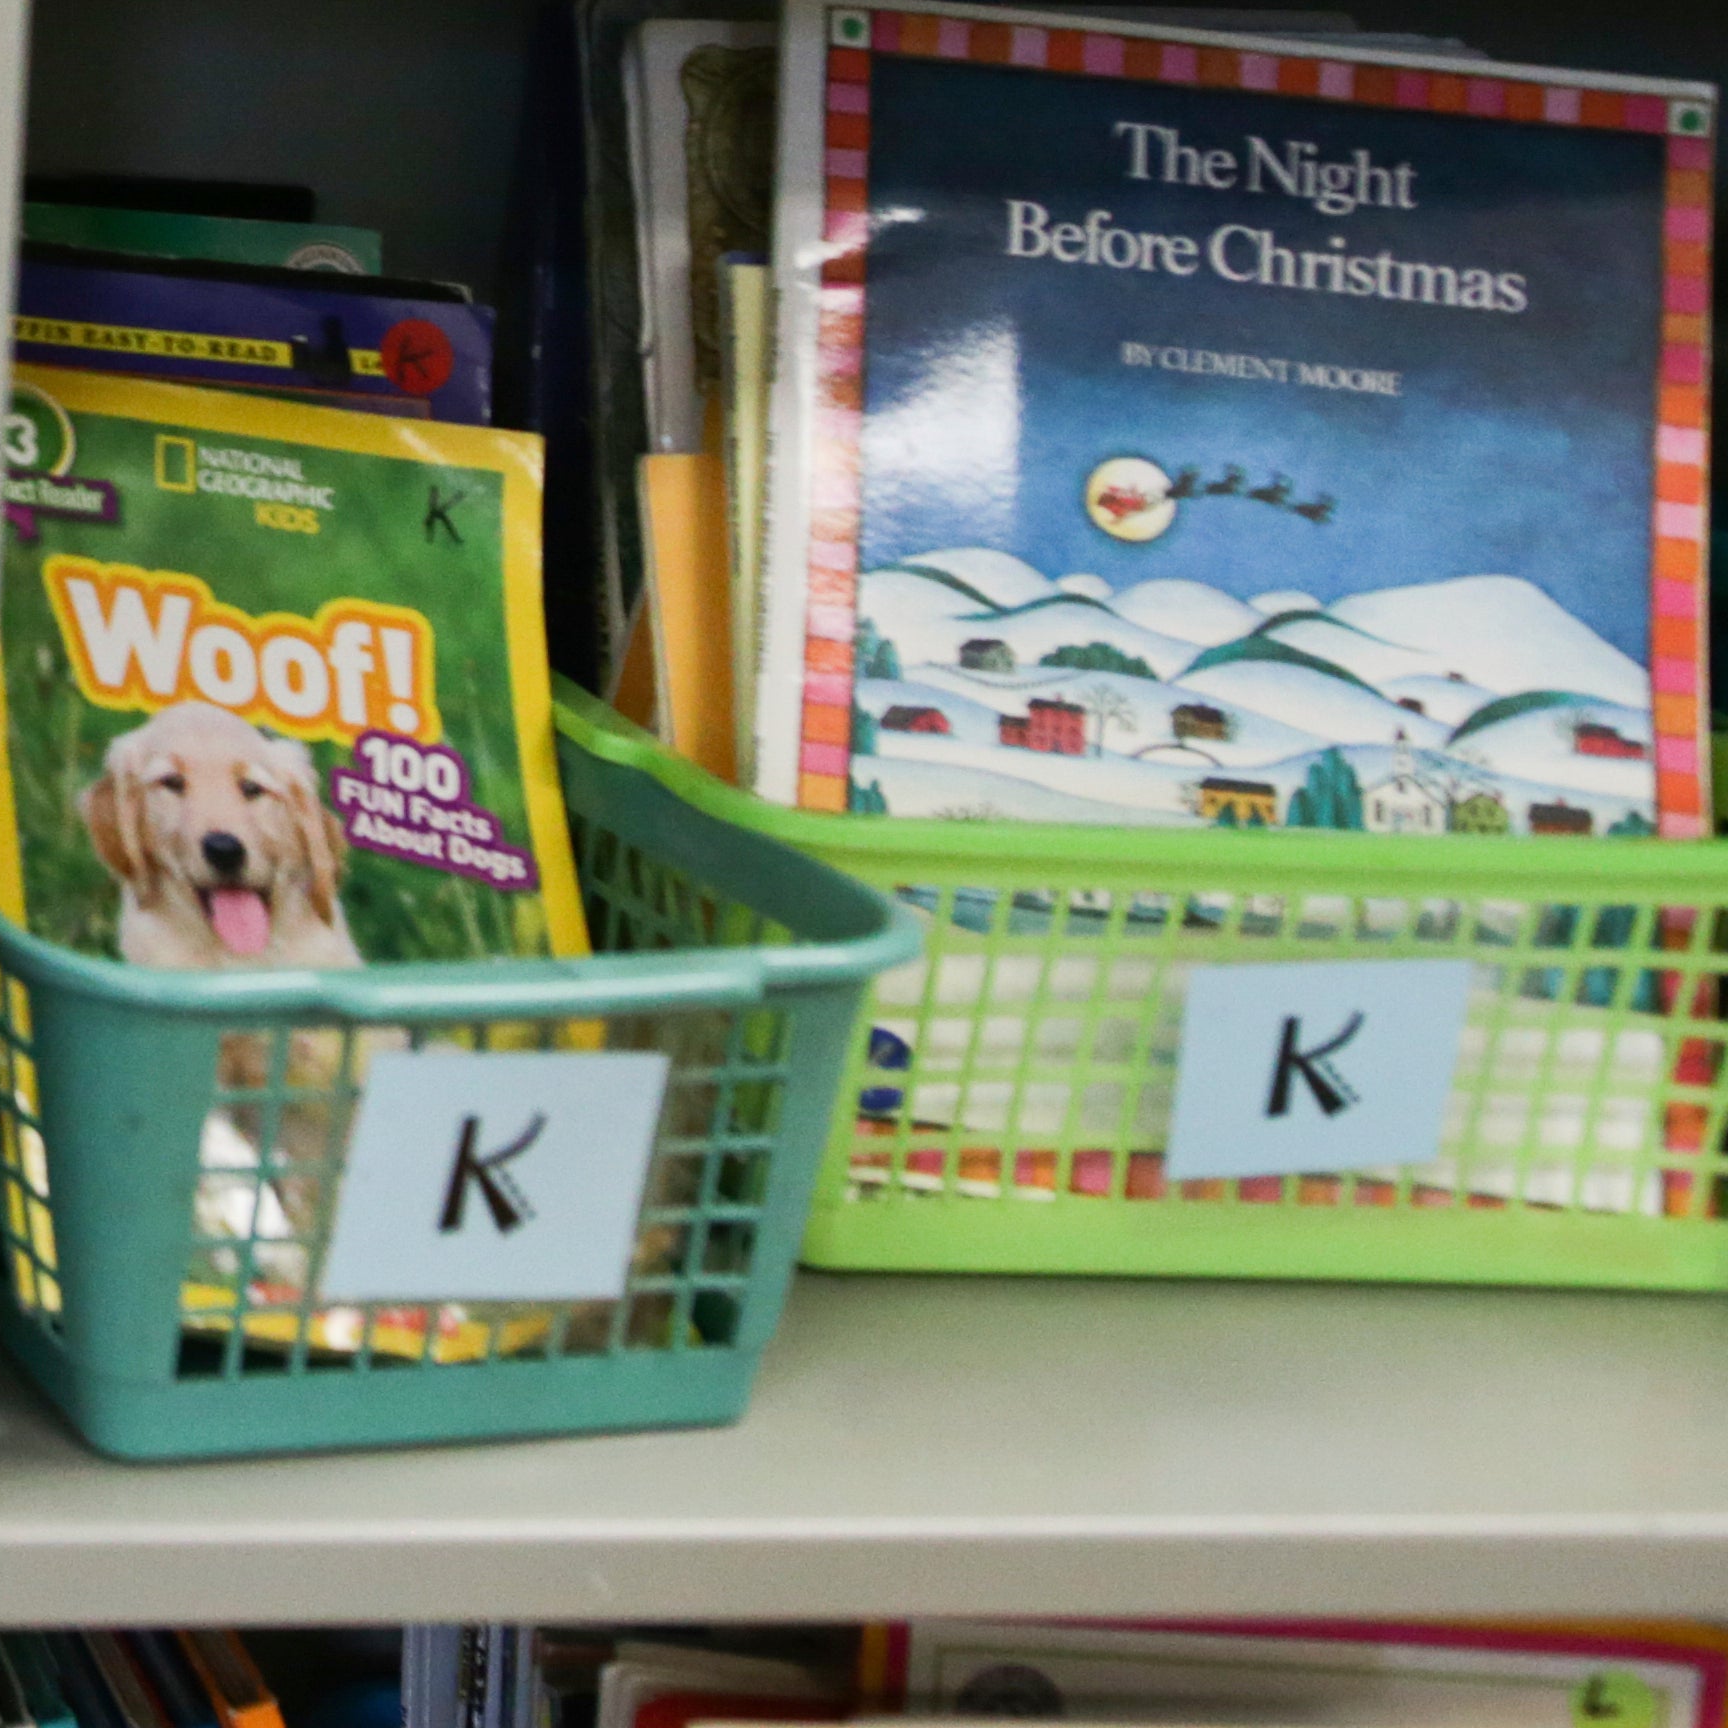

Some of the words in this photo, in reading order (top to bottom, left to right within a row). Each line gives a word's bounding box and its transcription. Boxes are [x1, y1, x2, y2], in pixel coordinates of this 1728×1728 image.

[1114, 122, 1238, 189] The
[1247, 137, 1417, 215] Night
[1005, 199, 1199, 276] Before
[1210, 224, 1528, 313] Christmas
[1121, 341, 1157, 367] BY
[1160, 347, 1291, 383] CLEMENT
[1298, 360, 1402, 397] MOORE
[3, 415, 38, 466] 3
[197, 445, 305, 482] NATIONAL
[43, 480, 103, 511] Reader
[197, 470, 335, 510] GEOGRAPHIC
[255, 502, 320, 535] KIDS
[423, 484, 465, 545] K
[65, 578, 420, 733] Woof!
[363, 738, 459, 801] 100
[338, 776, 407, 818] FUN
[410, 797, 492, 841] Facts
[353, 813, 444, 859] About
[448, 834, 526, 881] Dogs
[1265, 1012, 1363, 1119] K
[437, 1110, 546, 1234] K
